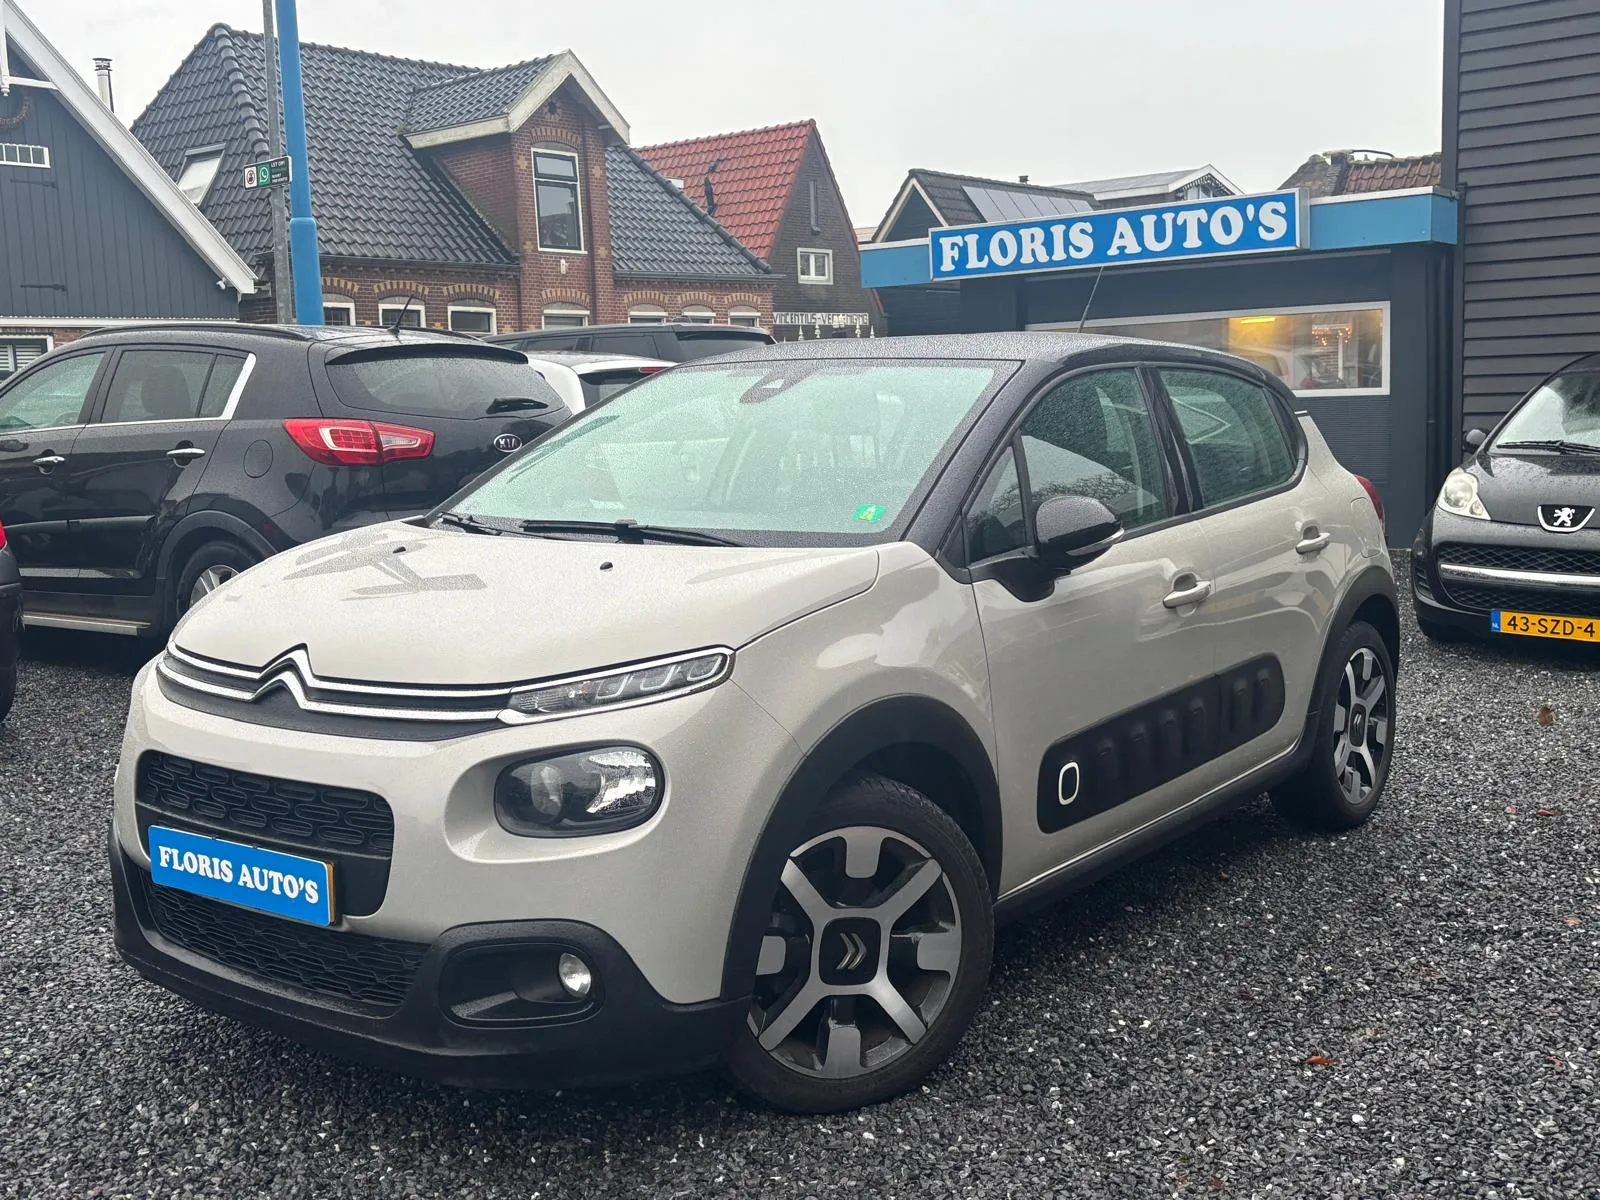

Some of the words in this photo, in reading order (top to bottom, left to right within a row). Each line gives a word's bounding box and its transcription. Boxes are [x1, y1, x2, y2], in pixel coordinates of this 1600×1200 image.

[940, 221, 1094, 272] FLORIS
[1107, 201, 1288, 256] AUTO'S
[498, 438, 519, 449] KIA
[1506, 615, 1596, 638] 43-SZD-4
[158, 845, 234, 883] FLORIS
[237, 864, 320, 904] AUTO'S
